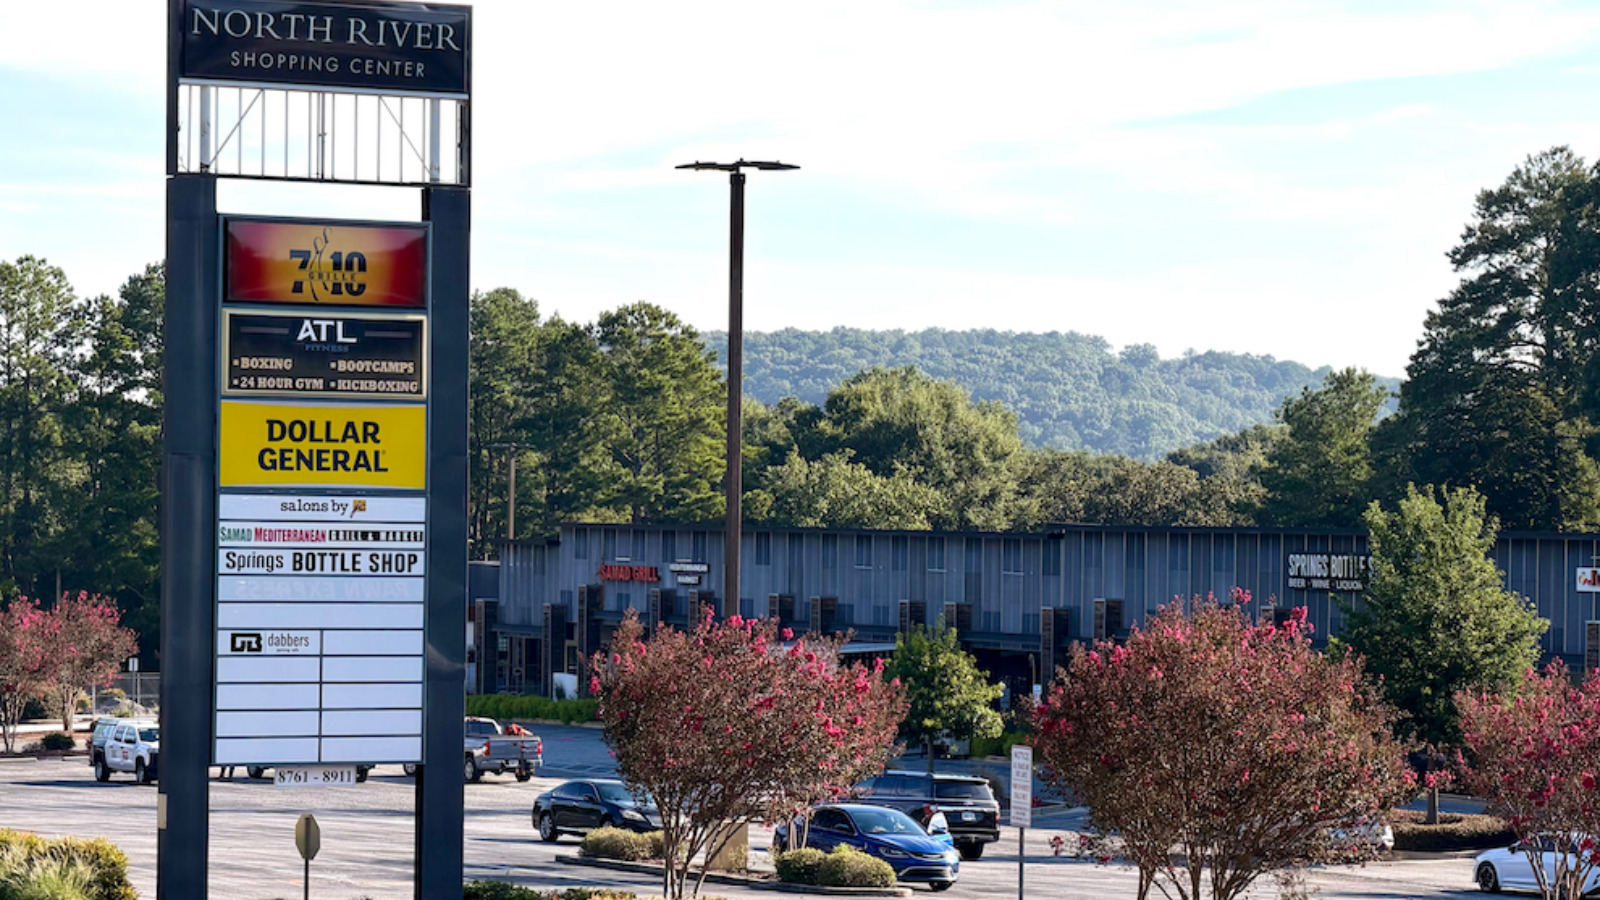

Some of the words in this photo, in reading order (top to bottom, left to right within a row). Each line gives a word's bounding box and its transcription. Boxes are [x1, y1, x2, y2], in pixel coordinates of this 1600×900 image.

[191, 8, 333, 43] NORTH
[346, 17, 461, 51] RIVER
[230, 51, 339, 73] SHOPPING
[350, 57, 425, 78] CENTER
[308, 271, 357, 281] GRILLE
[330, 251, 367, 297] 10
[297, 319, 357, 343] ATL
[304, 344, 349, 353] FITNESS
[240, 357, 293, 370] BOXING
[337, 360, 415, 374] BOOTCAMPS
[240, 377, 255, 389] 24
[257, 377, 293, 390] HOUR
[295, 378, 324, 390] GYM
[337, 379, 419, 392] KICKBOXING
[266, 419, 381, 444] DOLLAR
[257, 447, 389, 473] GENERAL
[280, 499, 329, 512] salons
[331, 499, 349, 516] by
[225, 551, 284, 572] Springs
[292, 552, 362, 573] BOTTLE
[369, 553, 418, 573] SHOP
[1288, 554, 1329, 577] SPRINGS
[632, 565, 659, 582] GRILL
[1288, 578, 1306, 588] BEER
[1310, 578, 1330, 589] WINE
[268, 633, 309, 647] dabbers
[278, 770, 309, 783] 8761
[322, 771, 352, 783] 8911
